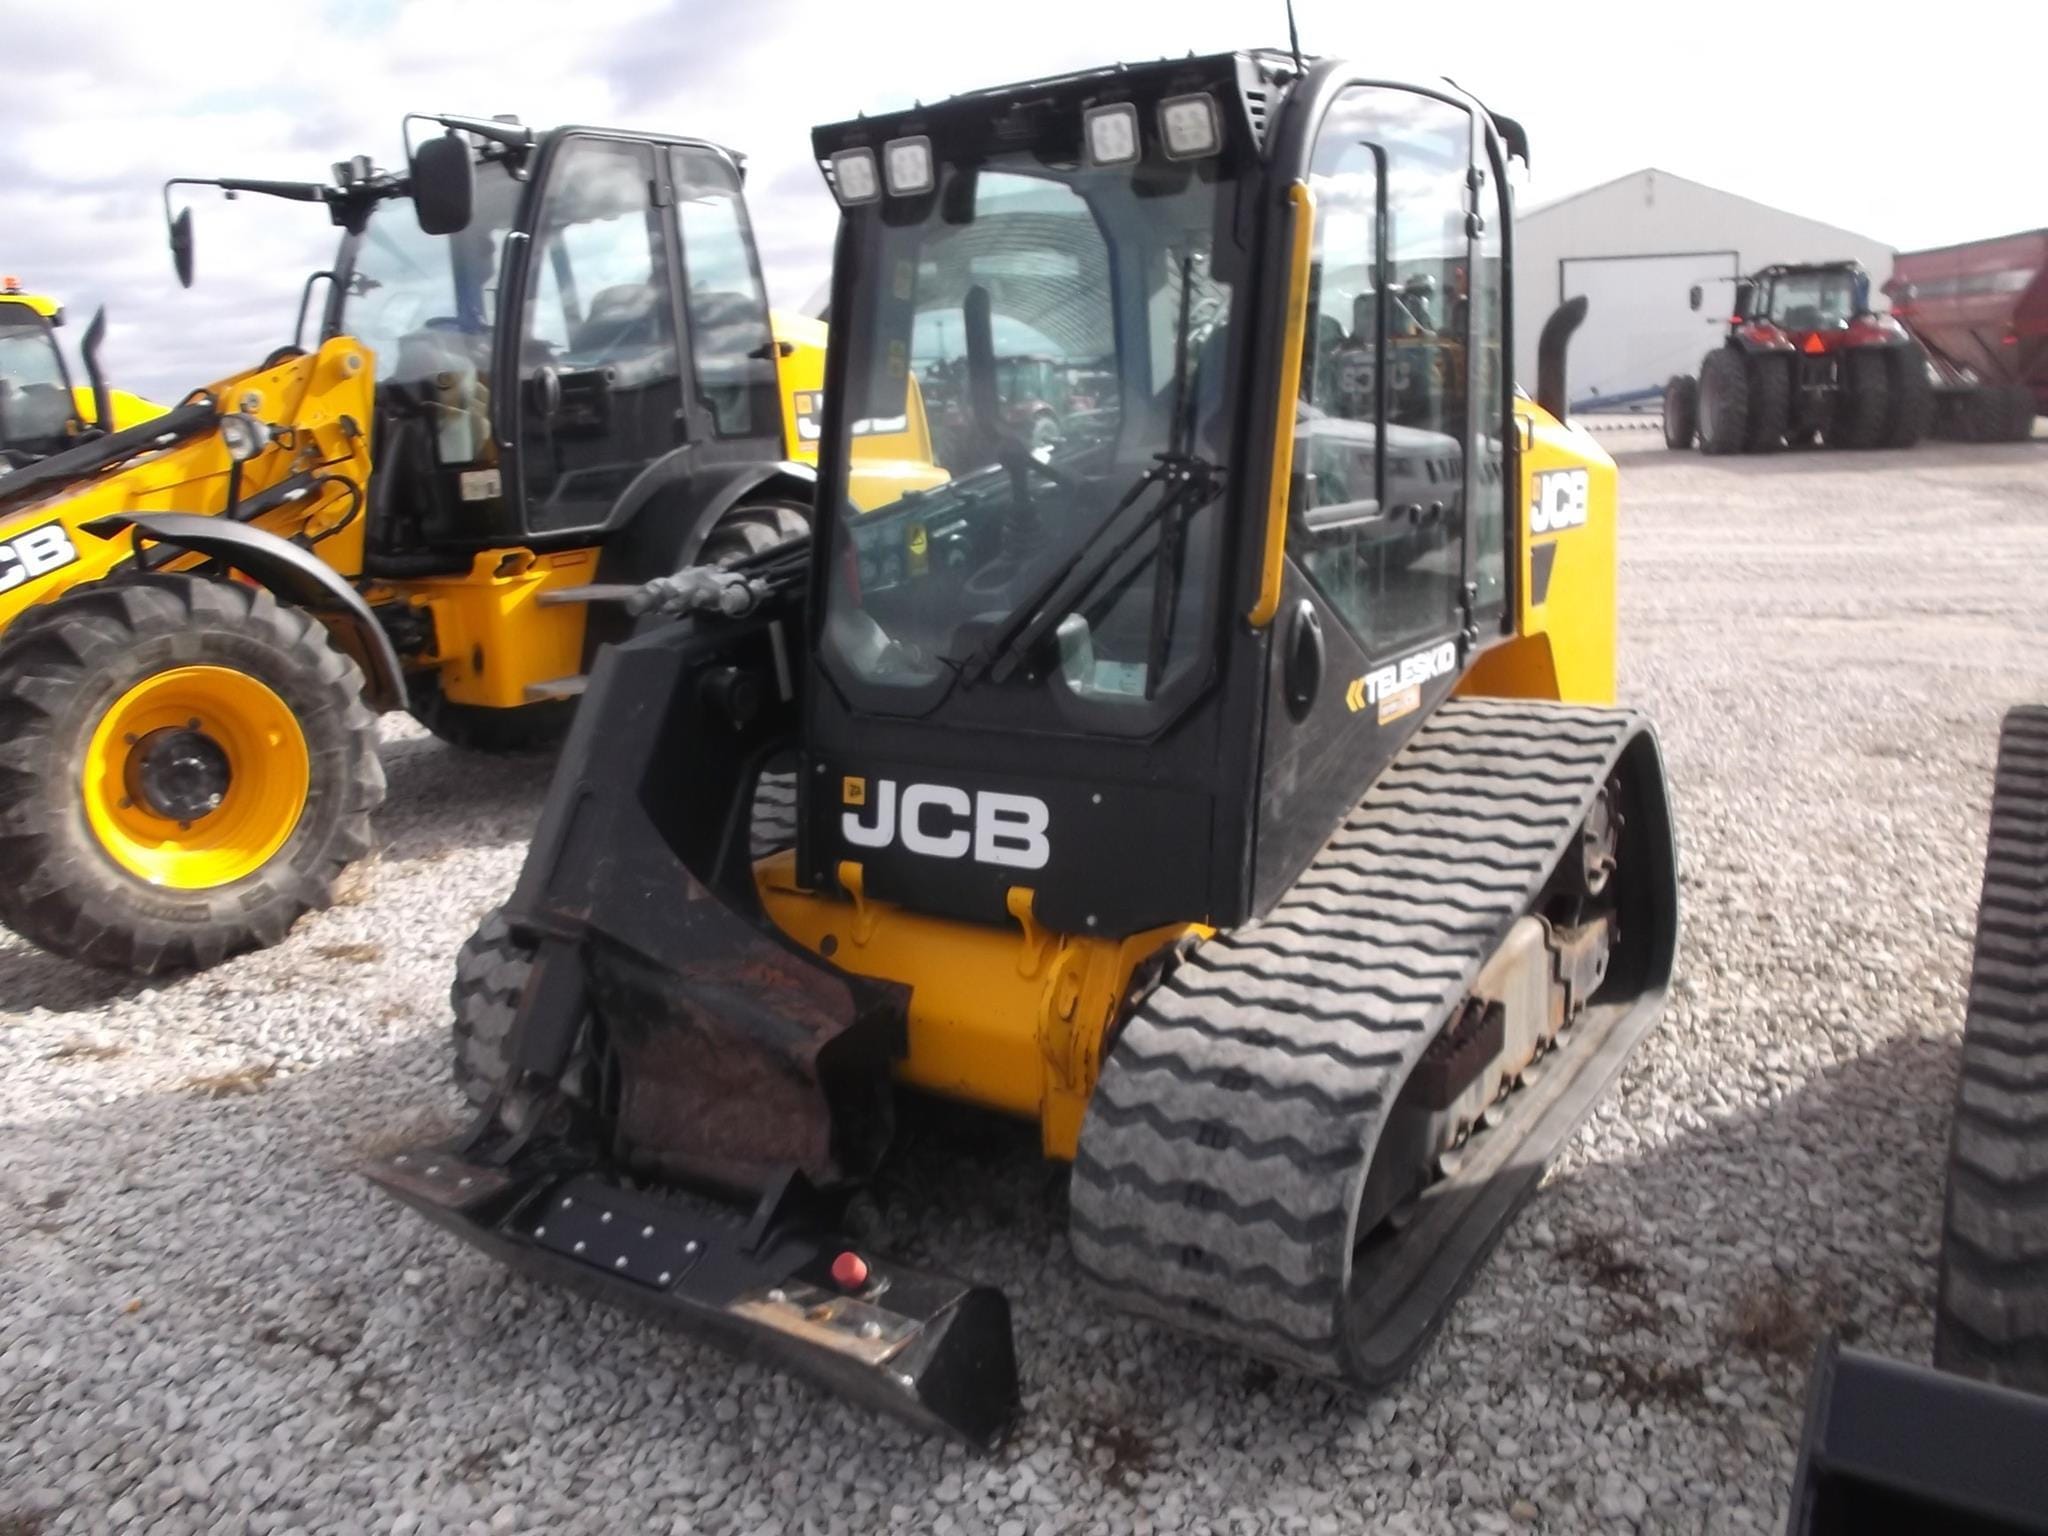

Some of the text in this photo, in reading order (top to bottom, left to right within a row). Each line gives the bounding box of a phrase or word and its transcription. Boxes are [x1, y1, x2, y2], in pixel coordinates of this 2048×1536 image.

[1531, 470, 1588, 532] JCB
[1365, 642, 1455, 704] TELESKID
[842, 779, 1050, 870] JCB
